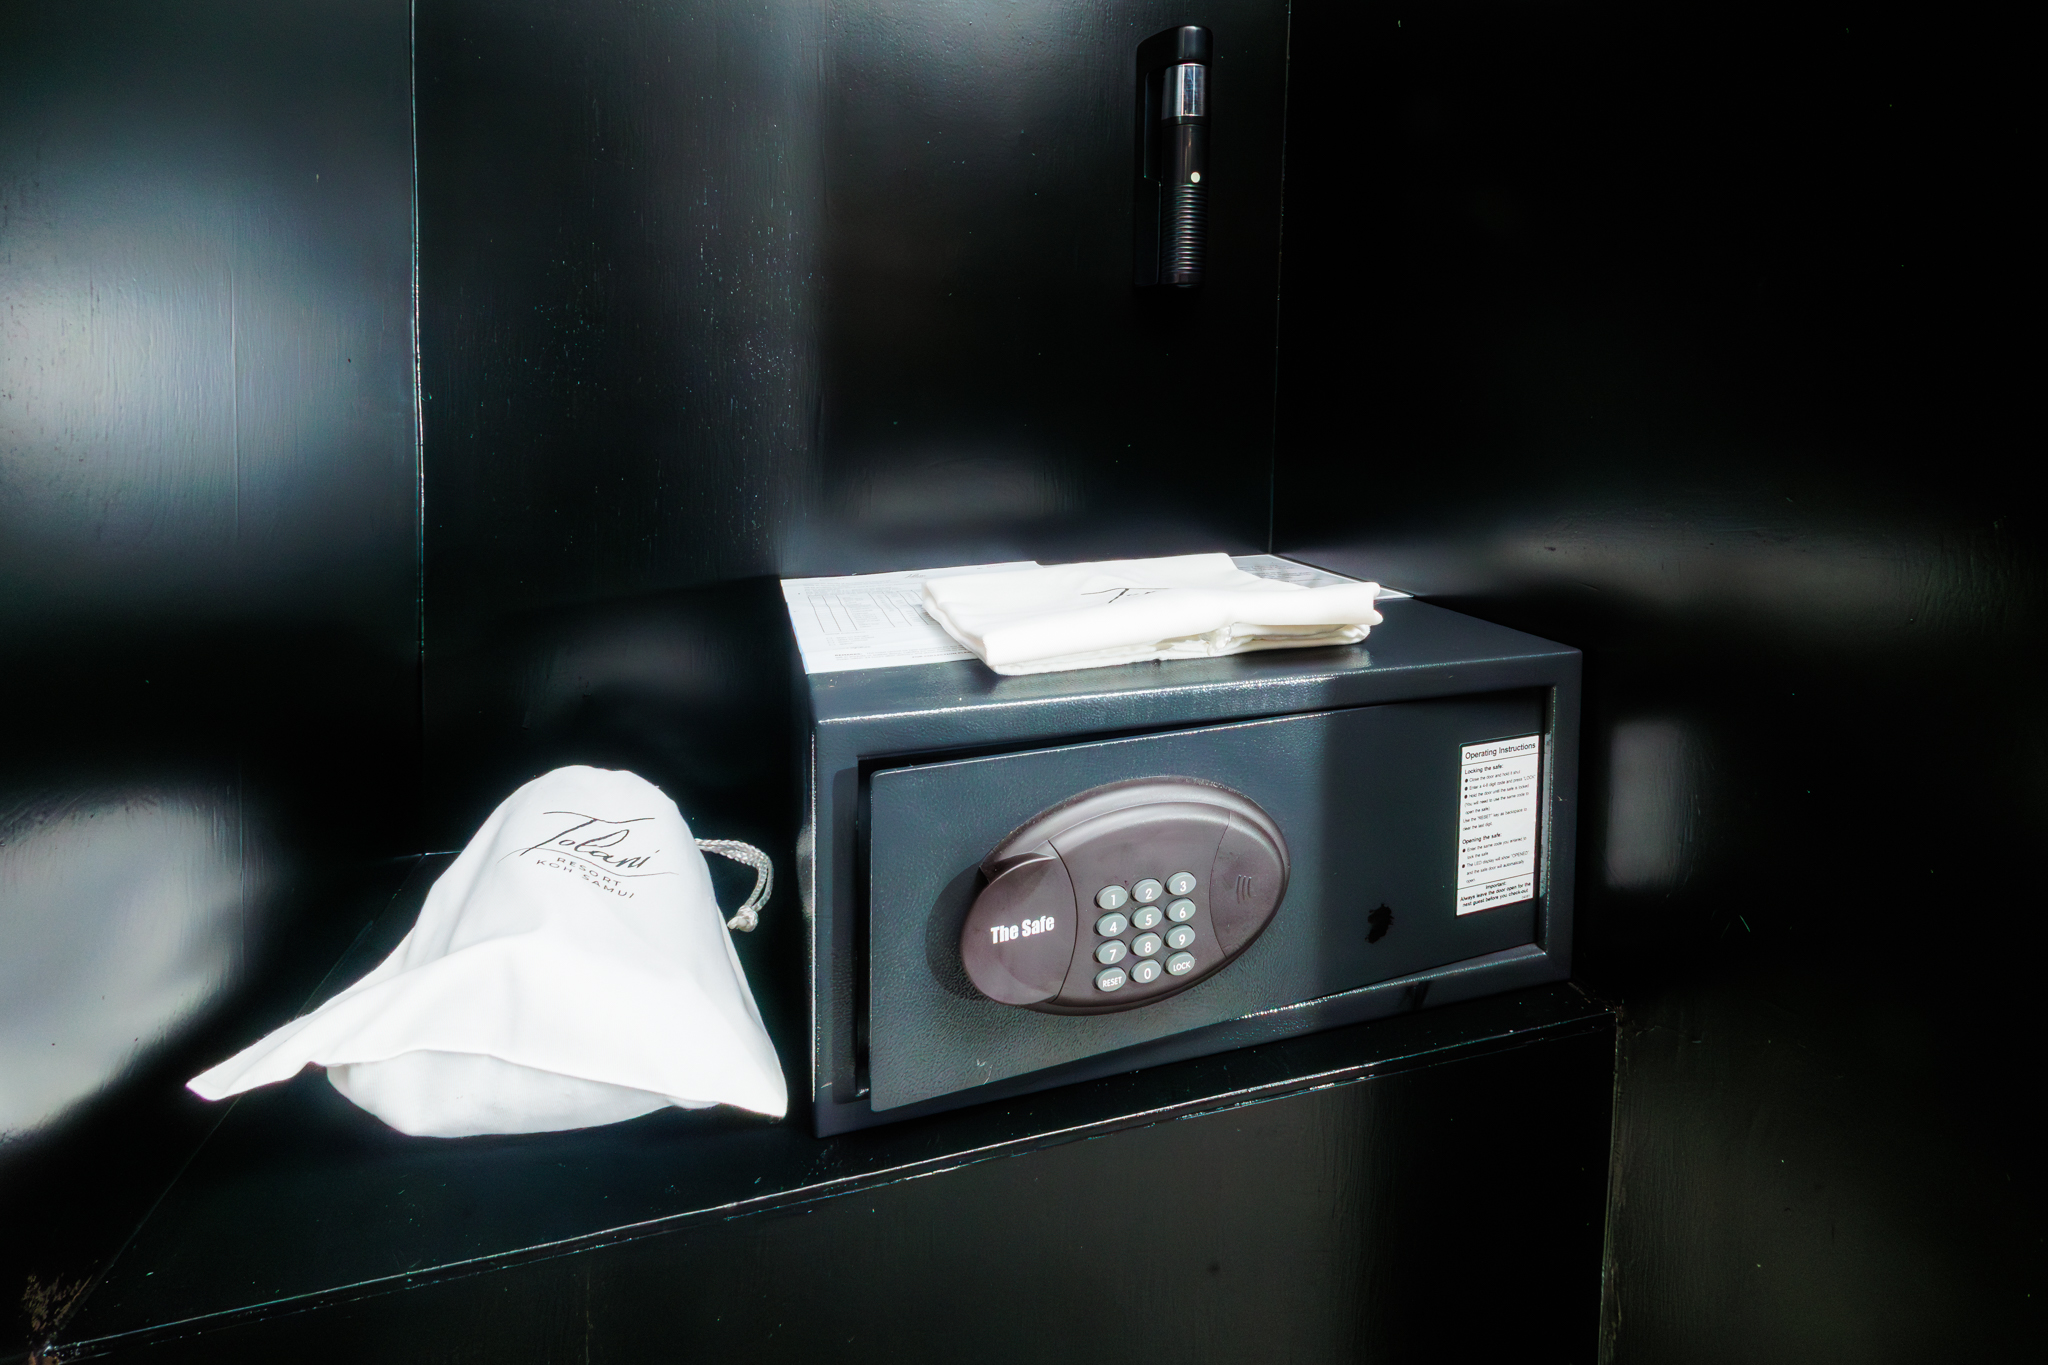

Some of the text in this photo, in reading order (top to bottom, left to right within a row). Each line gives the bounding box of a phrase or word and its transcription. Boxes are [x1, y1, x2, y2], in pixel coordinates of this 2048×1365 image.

[1465, 743, 1535, 759] Operating Instructions
[536, 860, 635, 899] KOH SAMUI
[557, 857, 622, 886] RESORT
[1110, 881, 1186, 905] 1 2 3
[991, 915, 1055, 944] The Safe
[1109, 907, 1186, 934] 4 5 6
[1109, 934, 1185, 961] 7 8 9
[1102, 960, 1191, 988] RESET 0 LOCK
